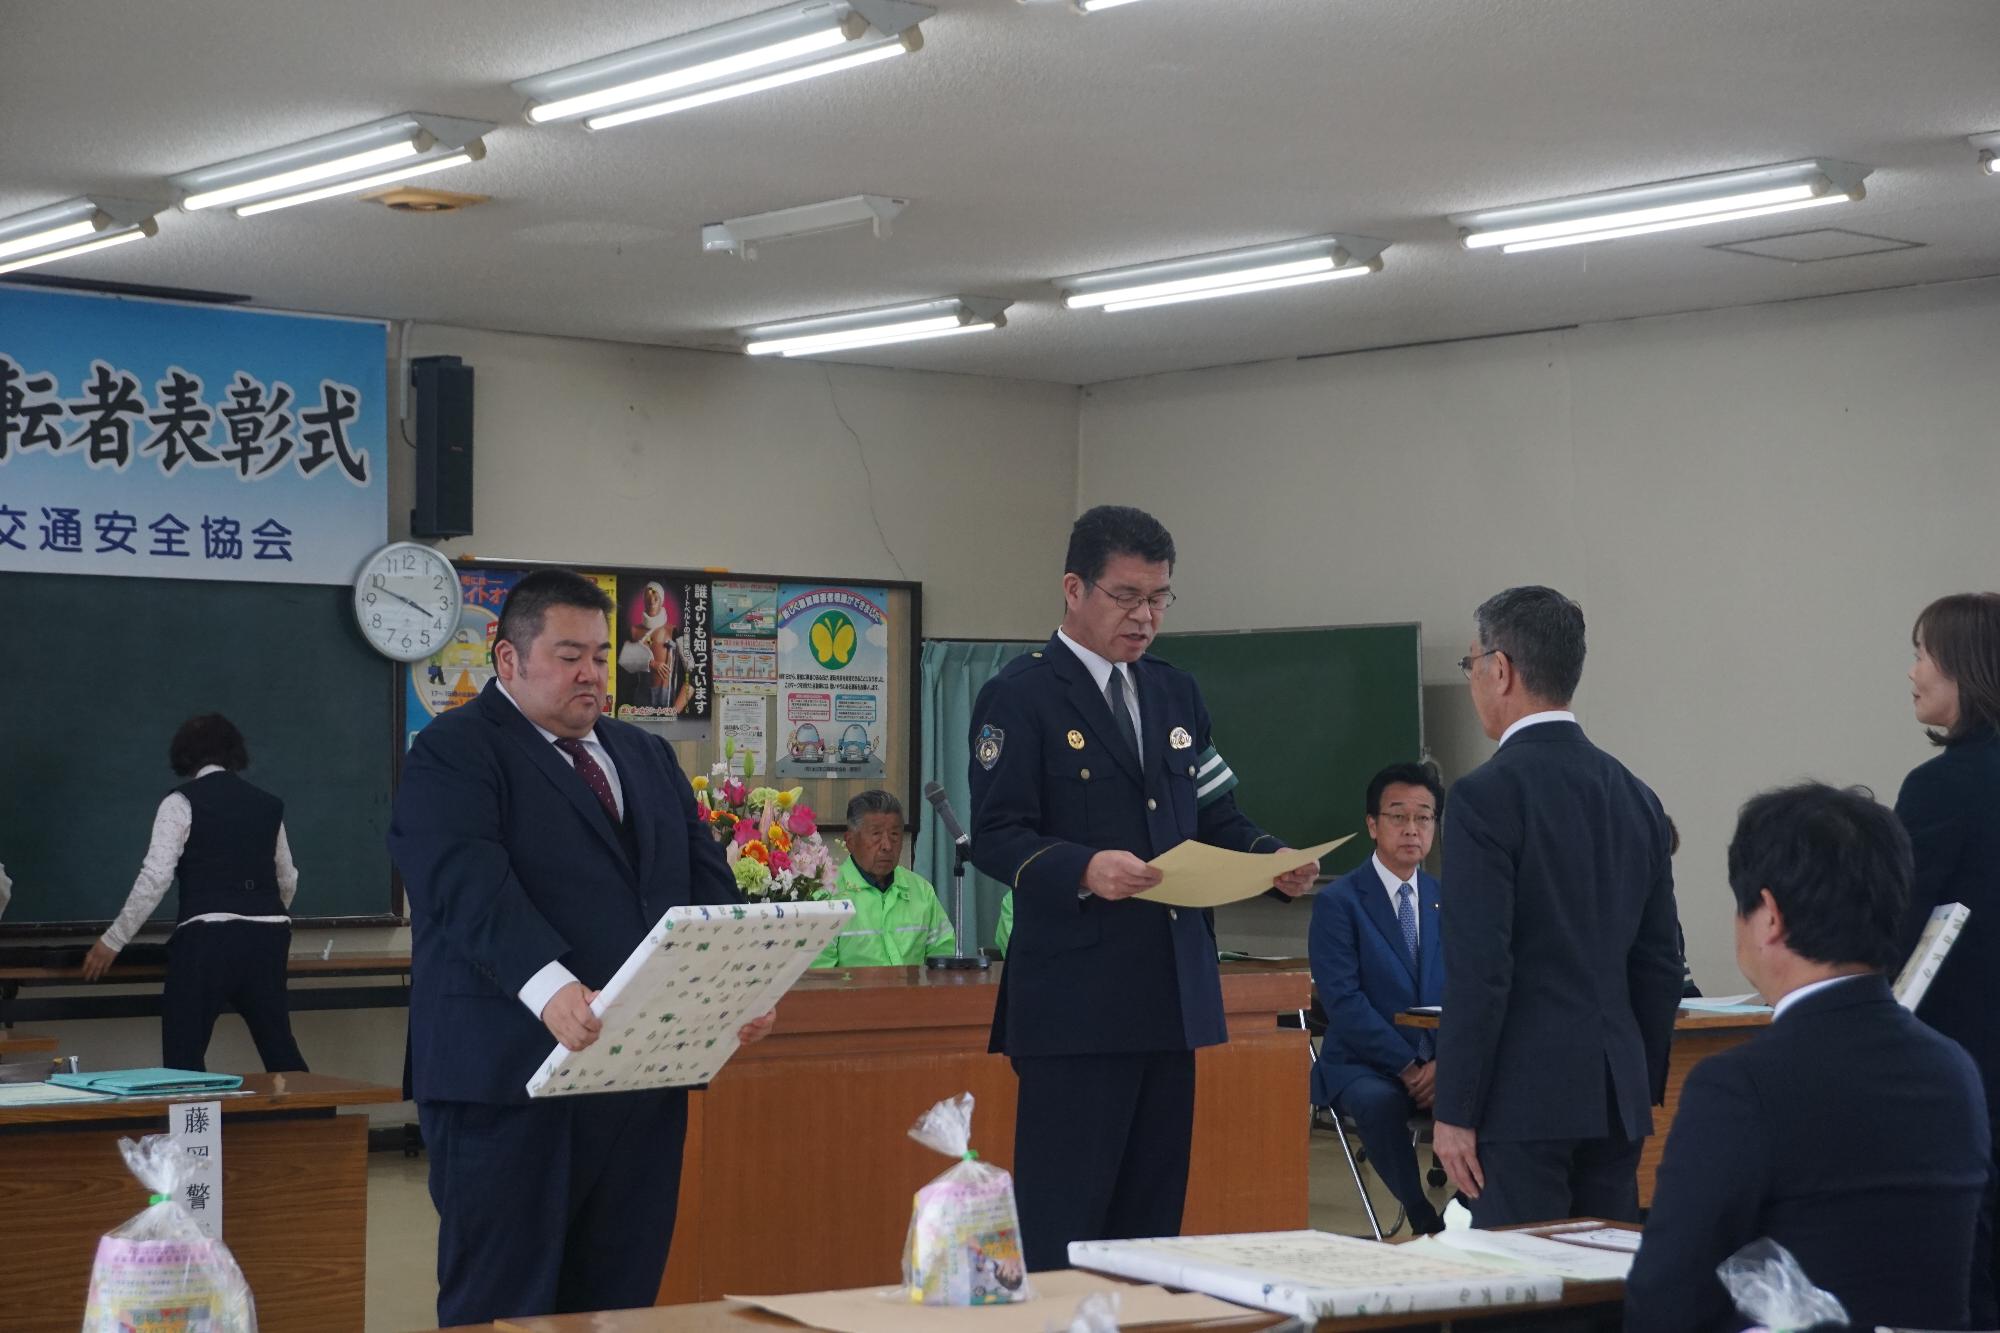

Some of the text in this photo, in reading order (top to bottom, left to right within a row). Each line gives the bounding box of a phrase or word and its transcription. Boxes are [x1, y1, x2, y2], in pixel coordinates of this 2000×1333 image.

[0, 359, 367, 482] 転者表彰式
[0, 505, 293, 561] 交通安全協会
[386, 557, 397, 573] 11
[402, 554, 416, 570] 12
[372, 573, 386, 588] 10
[433, 574, 443, 590] 2
[366, 592, 377, 607] 9
[439, 595, 449, 611] 3
[372, 613, 382, 629] 8
[433, 616, 442, 630] 4
[386, 628, 396, 644] 7
[401, 633, 412, 649] 6
[419, 629, 430, 645] 5
[694, 583, 708, 714] 誰よりも知っています
[185, 1106, 210, 1228] 藤警
